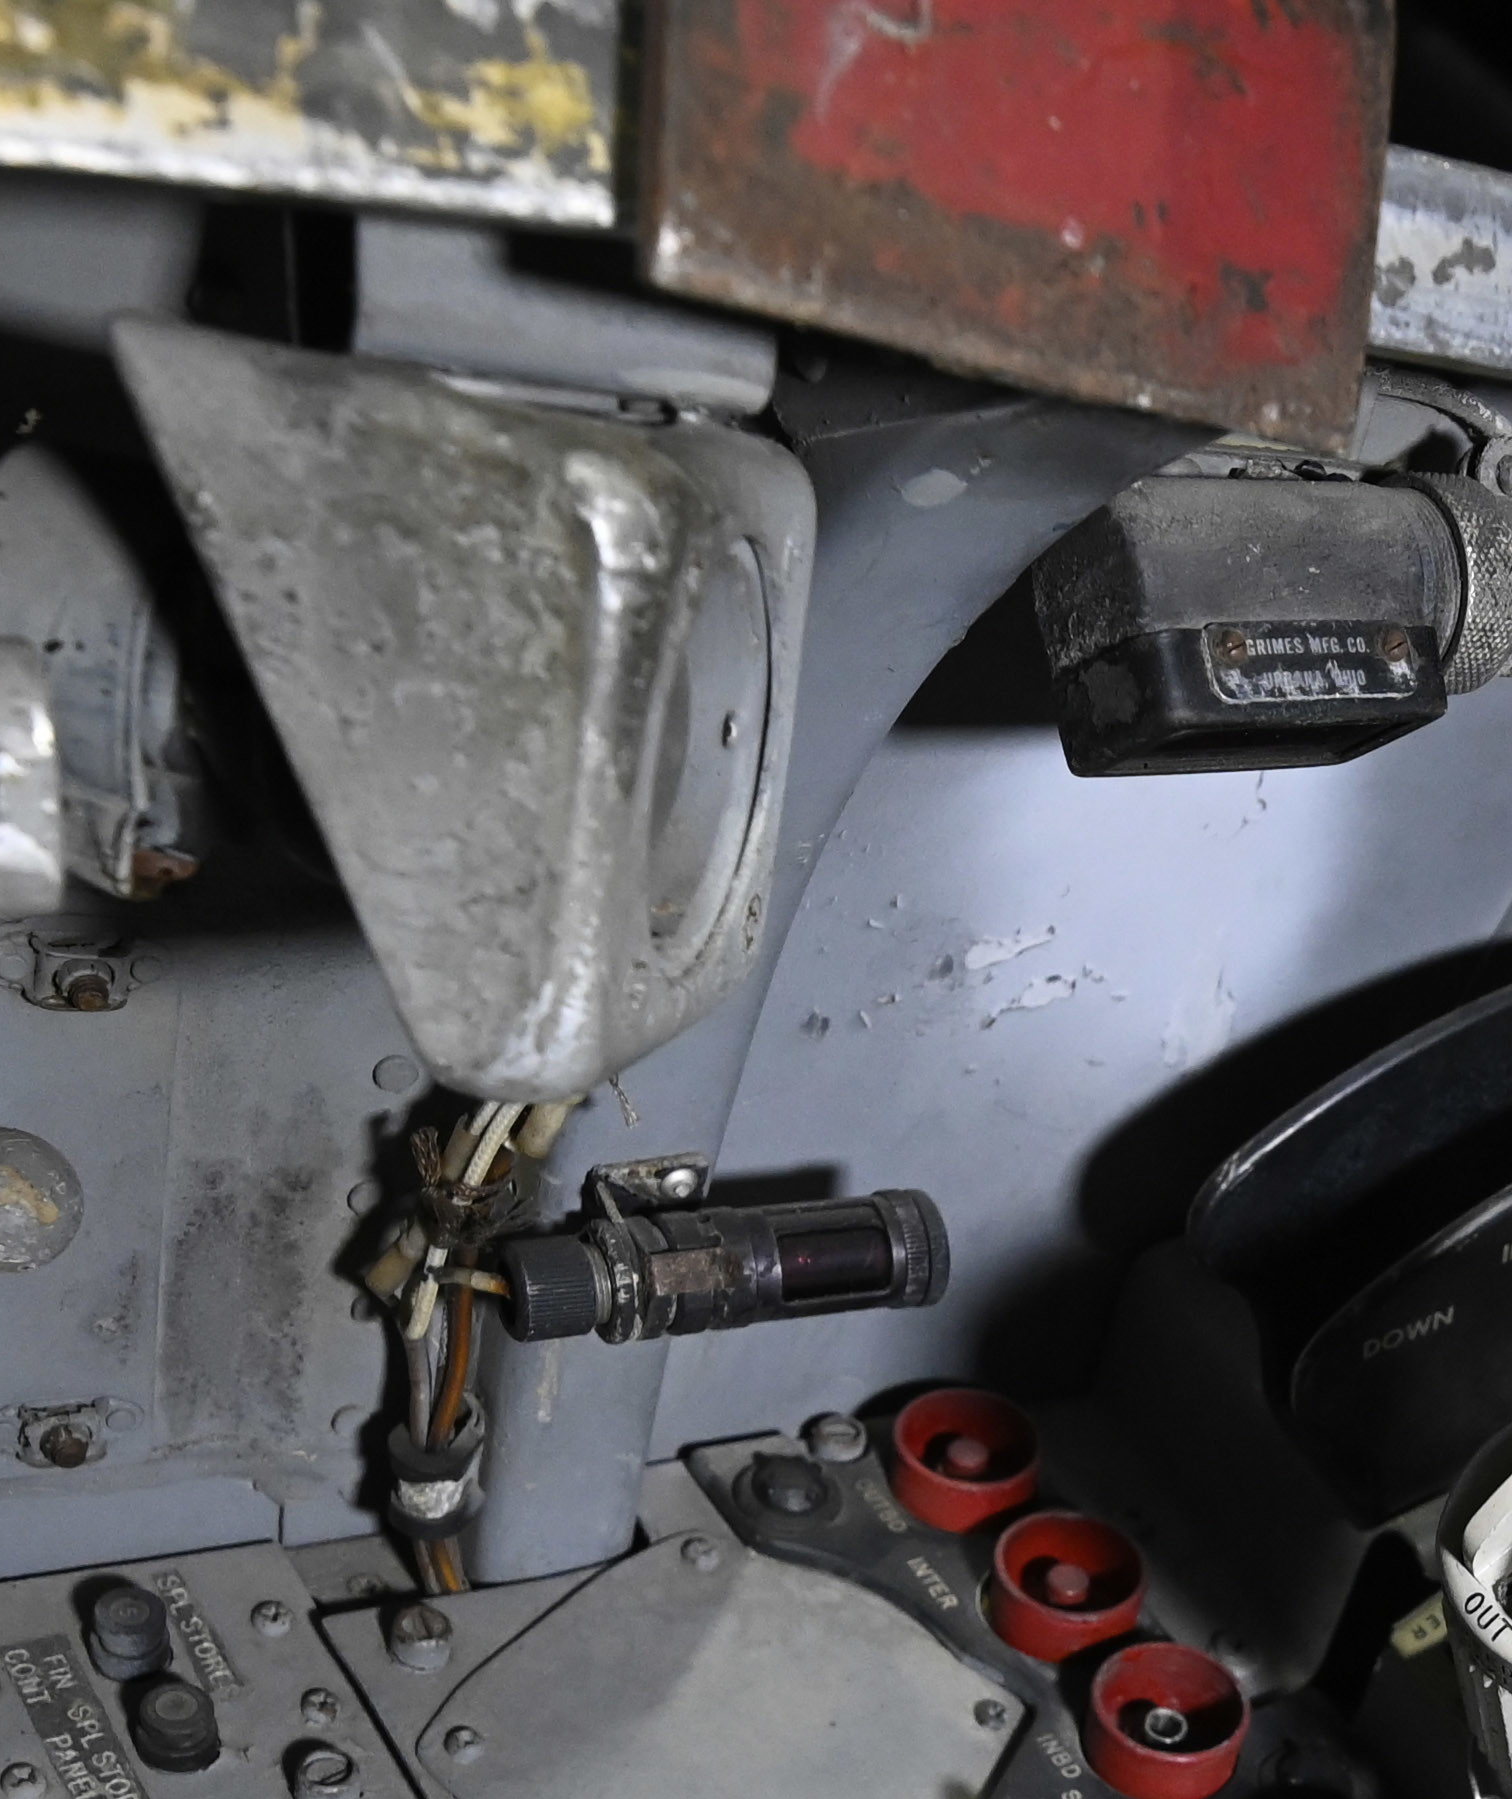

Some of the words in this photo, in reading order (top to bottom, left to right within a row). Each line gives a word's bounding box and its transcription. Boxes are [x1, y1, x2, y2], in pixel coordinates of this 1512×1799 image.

[1245, 637, 1303, 656] GRIMES
[1308, 634, 1345, 655] MFG.
[1347, 636, 1370, 654] CO.
[1362, 1304, 1458, 1362] DOWN
[155, 1574, 192, 1617] SPL
[906, 1555, 959, 1612] INTER
[3, 1646, 52, 1706] CONT
[43, 1652, 76, 1692] FIN
[66, 1702, 106, 1751] SPL
[1036, 1732, 1083, 1781] INBD
